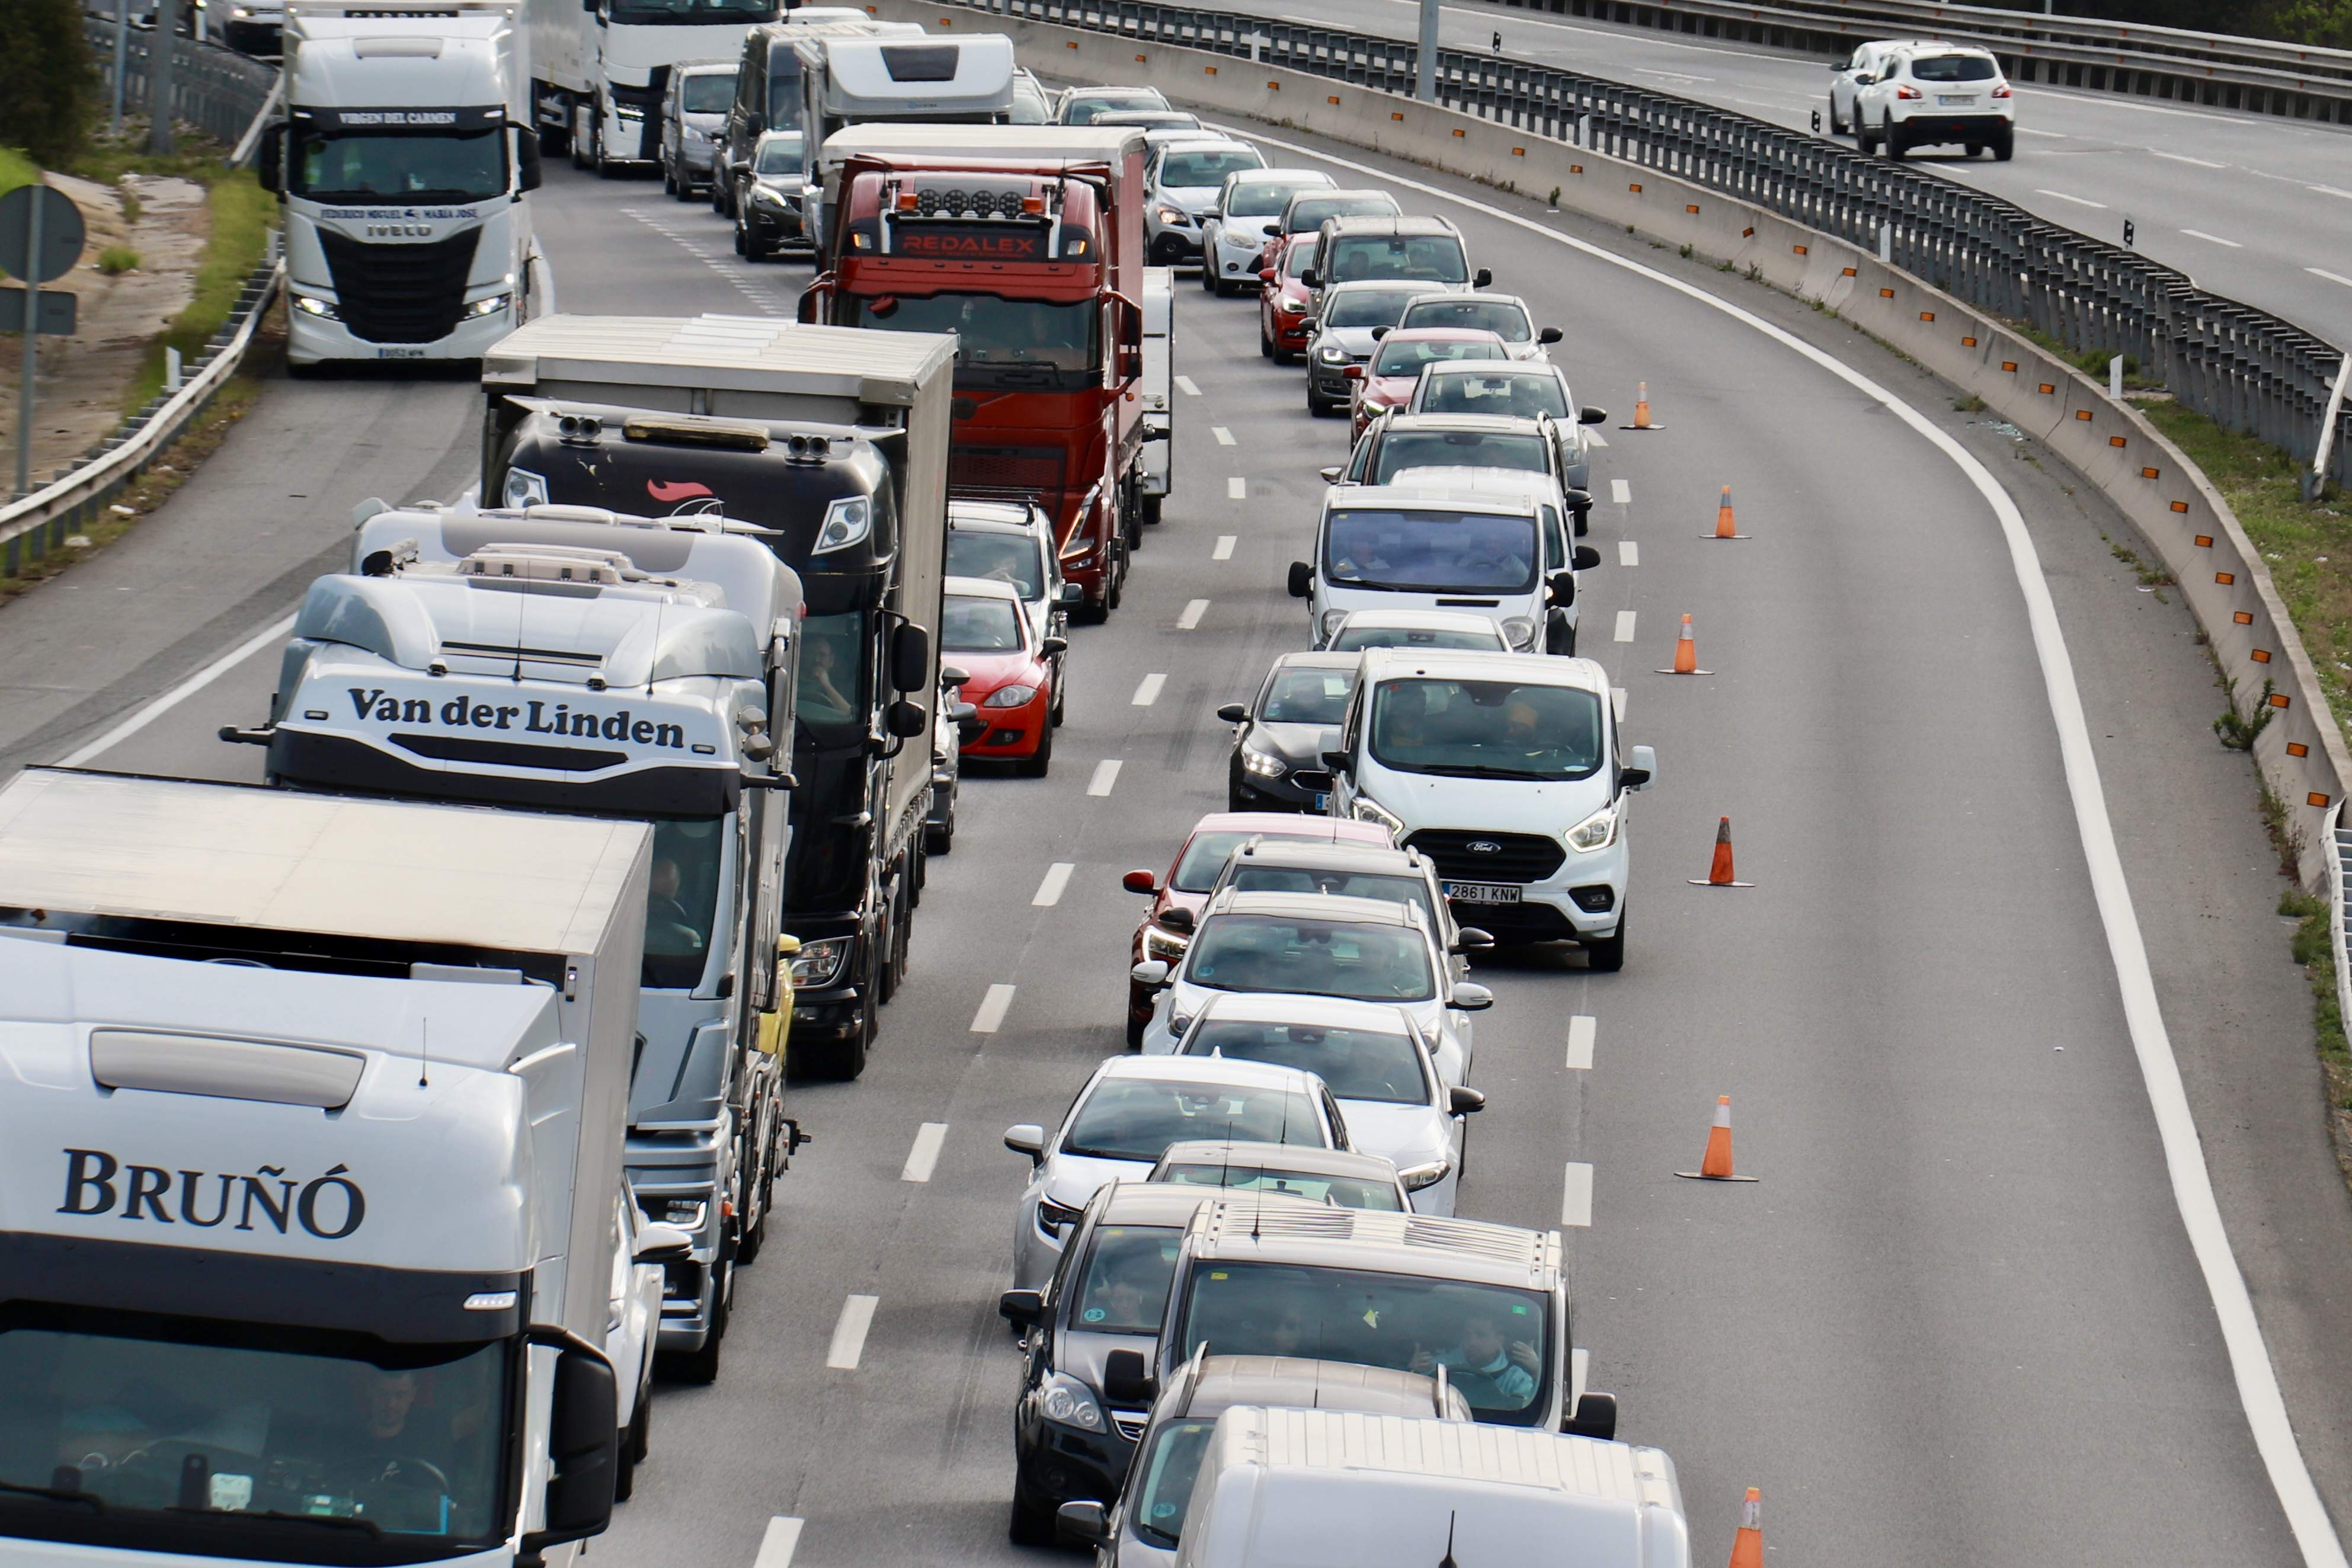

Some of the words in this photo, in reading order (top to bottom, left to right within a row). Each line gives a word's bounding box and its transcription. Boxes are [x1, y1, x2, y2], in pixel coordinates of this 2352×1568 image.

[338, 113, 383, 124] VIRGEN
[384, 113, 406, 124] DEL
[407, 113, 456, 124] CARMEN
[367, 224, 432, 236] IVECO
[903, 235, 1034, 252] REDALEX
[347, 688, 431, 724] Van
[440, 695, 519, 729] der
[525, 700, 684, 748] Linden
[1473, 843, 1493, 852] Ford
[1452, 885, 1485, 900] 2861
[1491, 888, 1518, 901] KNW
[56, 1148, 366, 1240] BRUÑÓ
